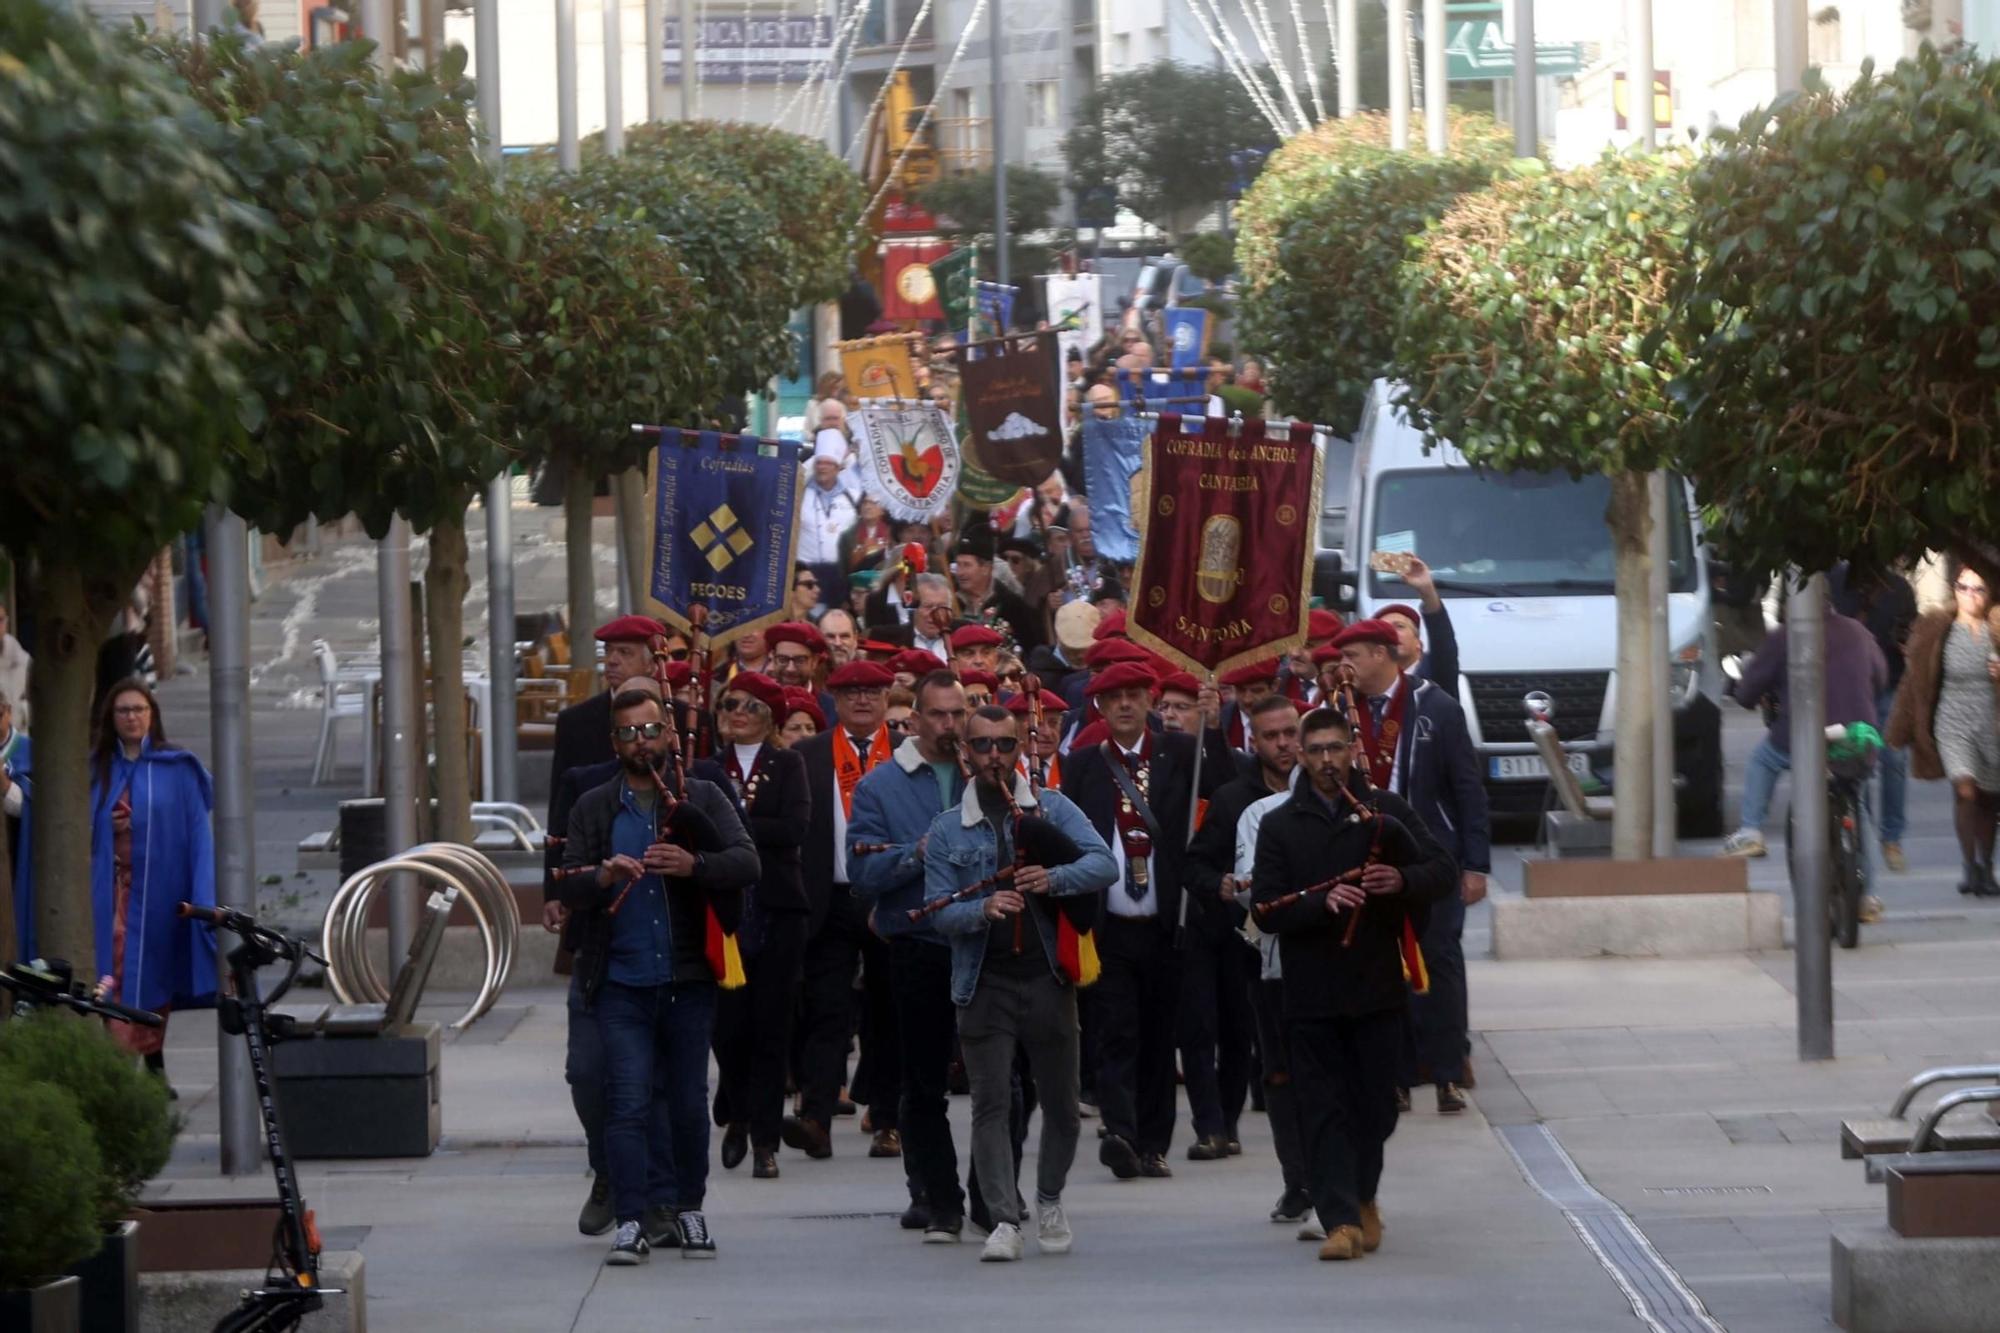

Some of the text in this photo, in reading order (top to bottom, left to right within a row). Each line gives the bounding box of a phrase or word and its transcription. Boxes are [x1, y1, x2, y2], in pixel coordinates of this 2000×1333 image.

[662, 21, 829, 44] CLNICA DENTAL
[1250, 445, 1296, 463] ANCHOA
[895, 475, 951, 507] CANTABRIA
[690, 582, 746, 600] FECOES
